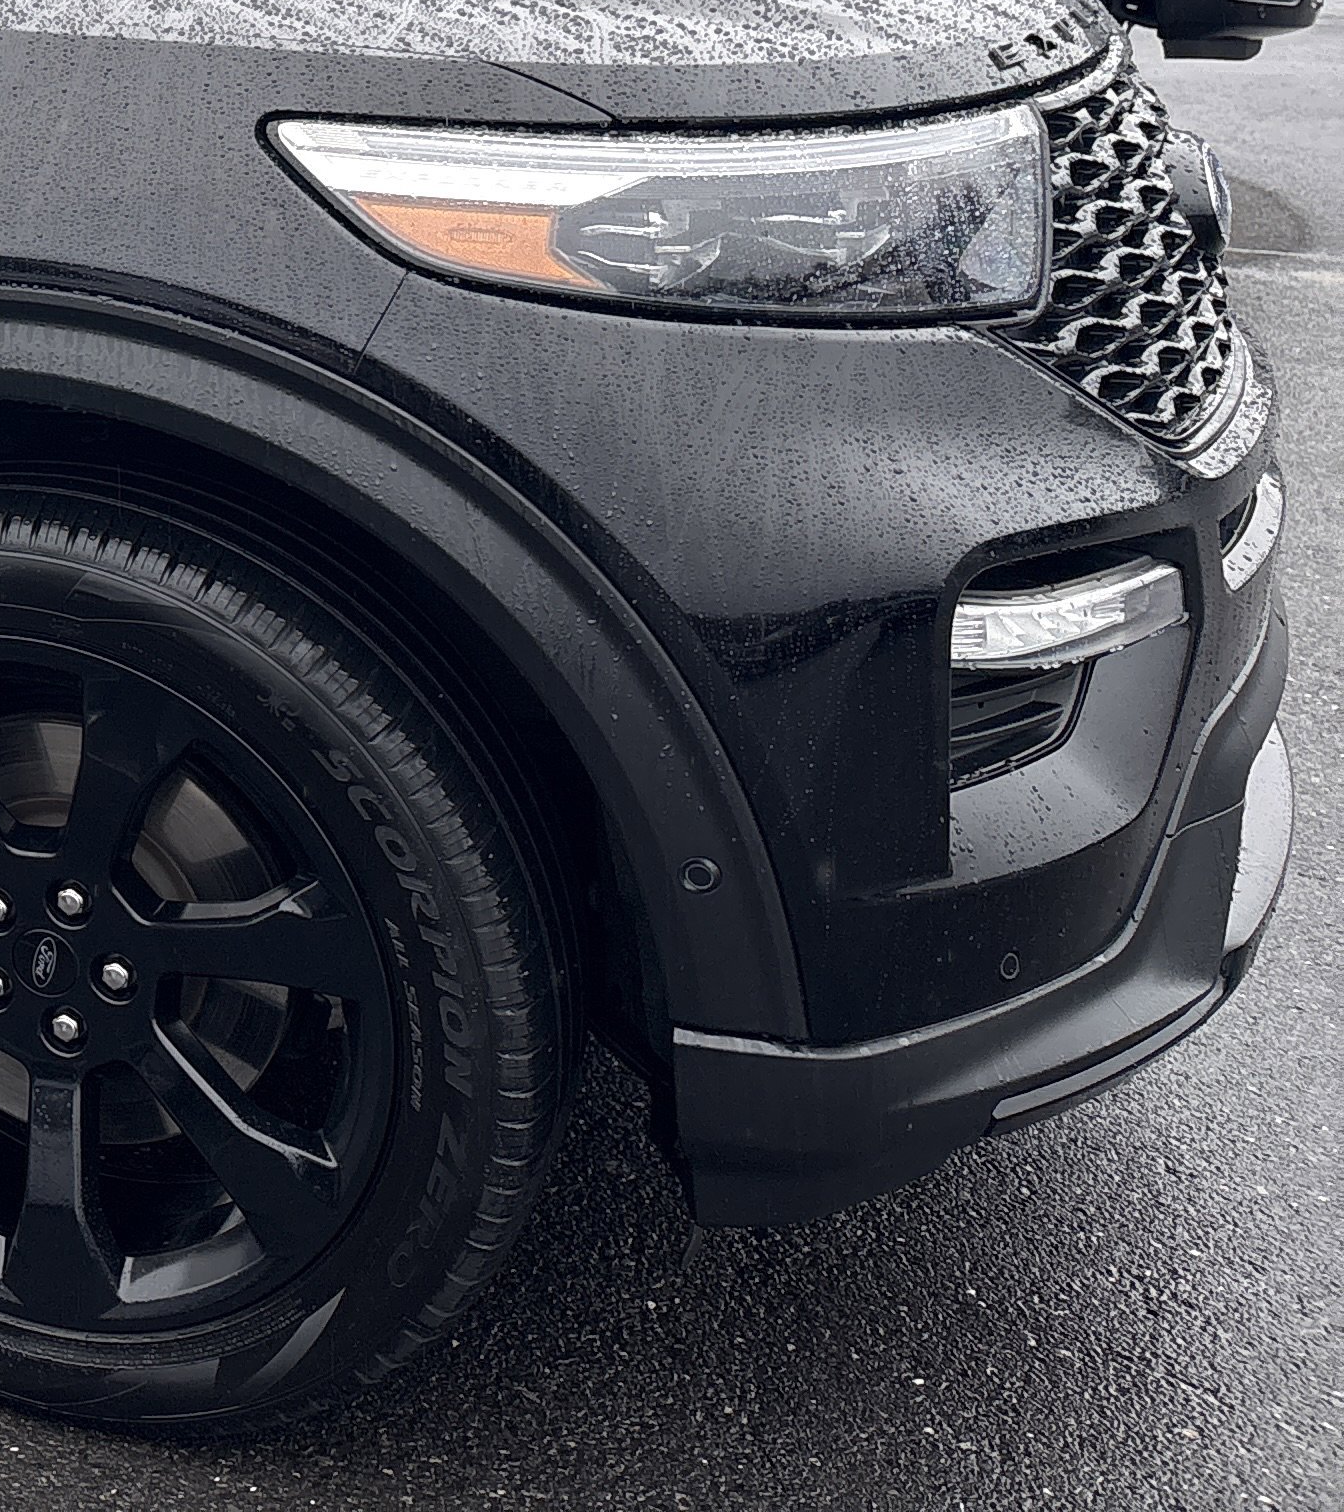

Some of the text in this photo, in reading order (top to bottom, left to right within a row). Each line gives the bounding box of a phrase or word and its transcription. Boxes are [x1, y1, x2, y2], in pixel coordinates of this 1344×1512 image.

[310, 746, 474, 1288] SCORPION ZERO
[383, 917, 424, 1113] ALL SEASON
